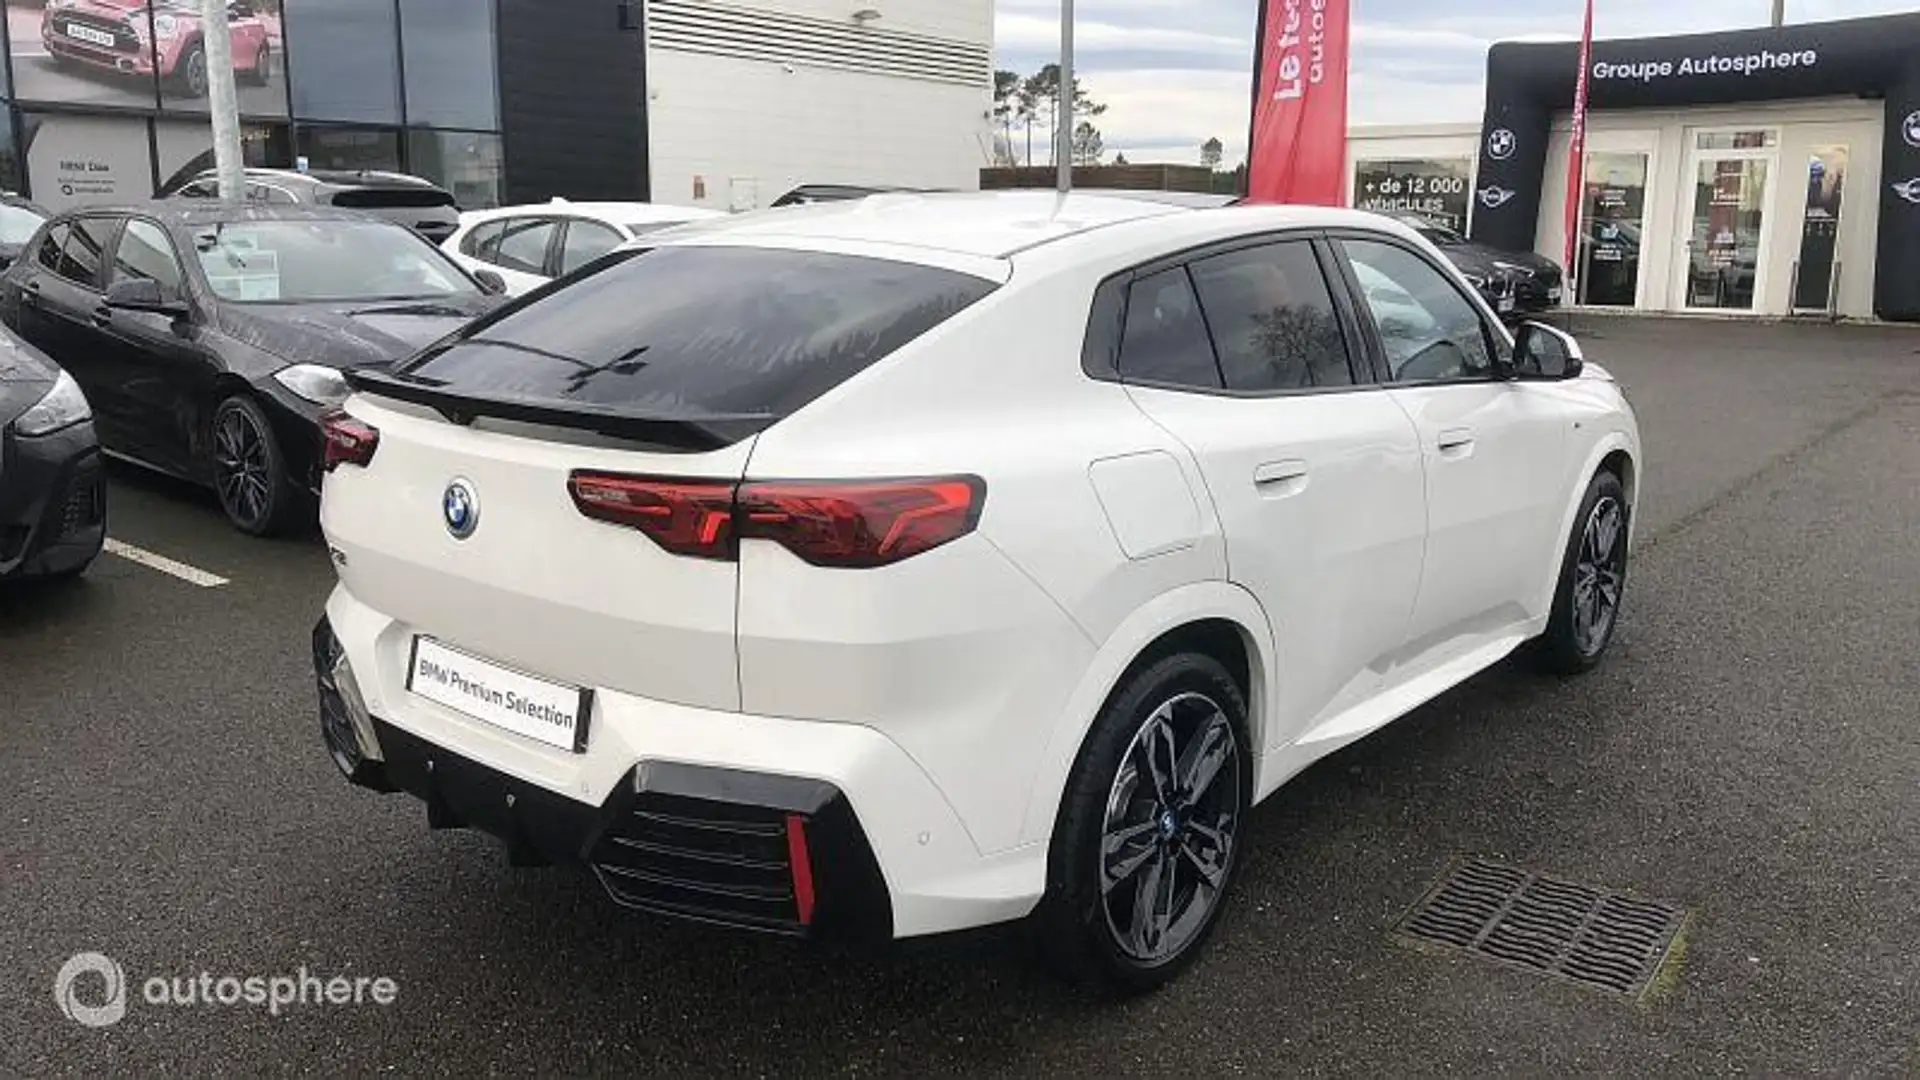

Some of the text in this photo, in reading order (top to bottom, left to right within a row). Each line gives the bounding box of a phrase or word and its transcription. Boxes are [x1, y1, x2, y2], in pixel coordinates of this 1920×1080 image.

[1274, 55, 1303, 99] Le
[1593, 50, 1817, 82] Groupe Autosphere
[1380, 178, 1402, 193] de
[1407, 178, 1425, 193] 12
[1430, 177, 1463, 193] 000
[419, 658, 573, 730] BMW Premium Selection
